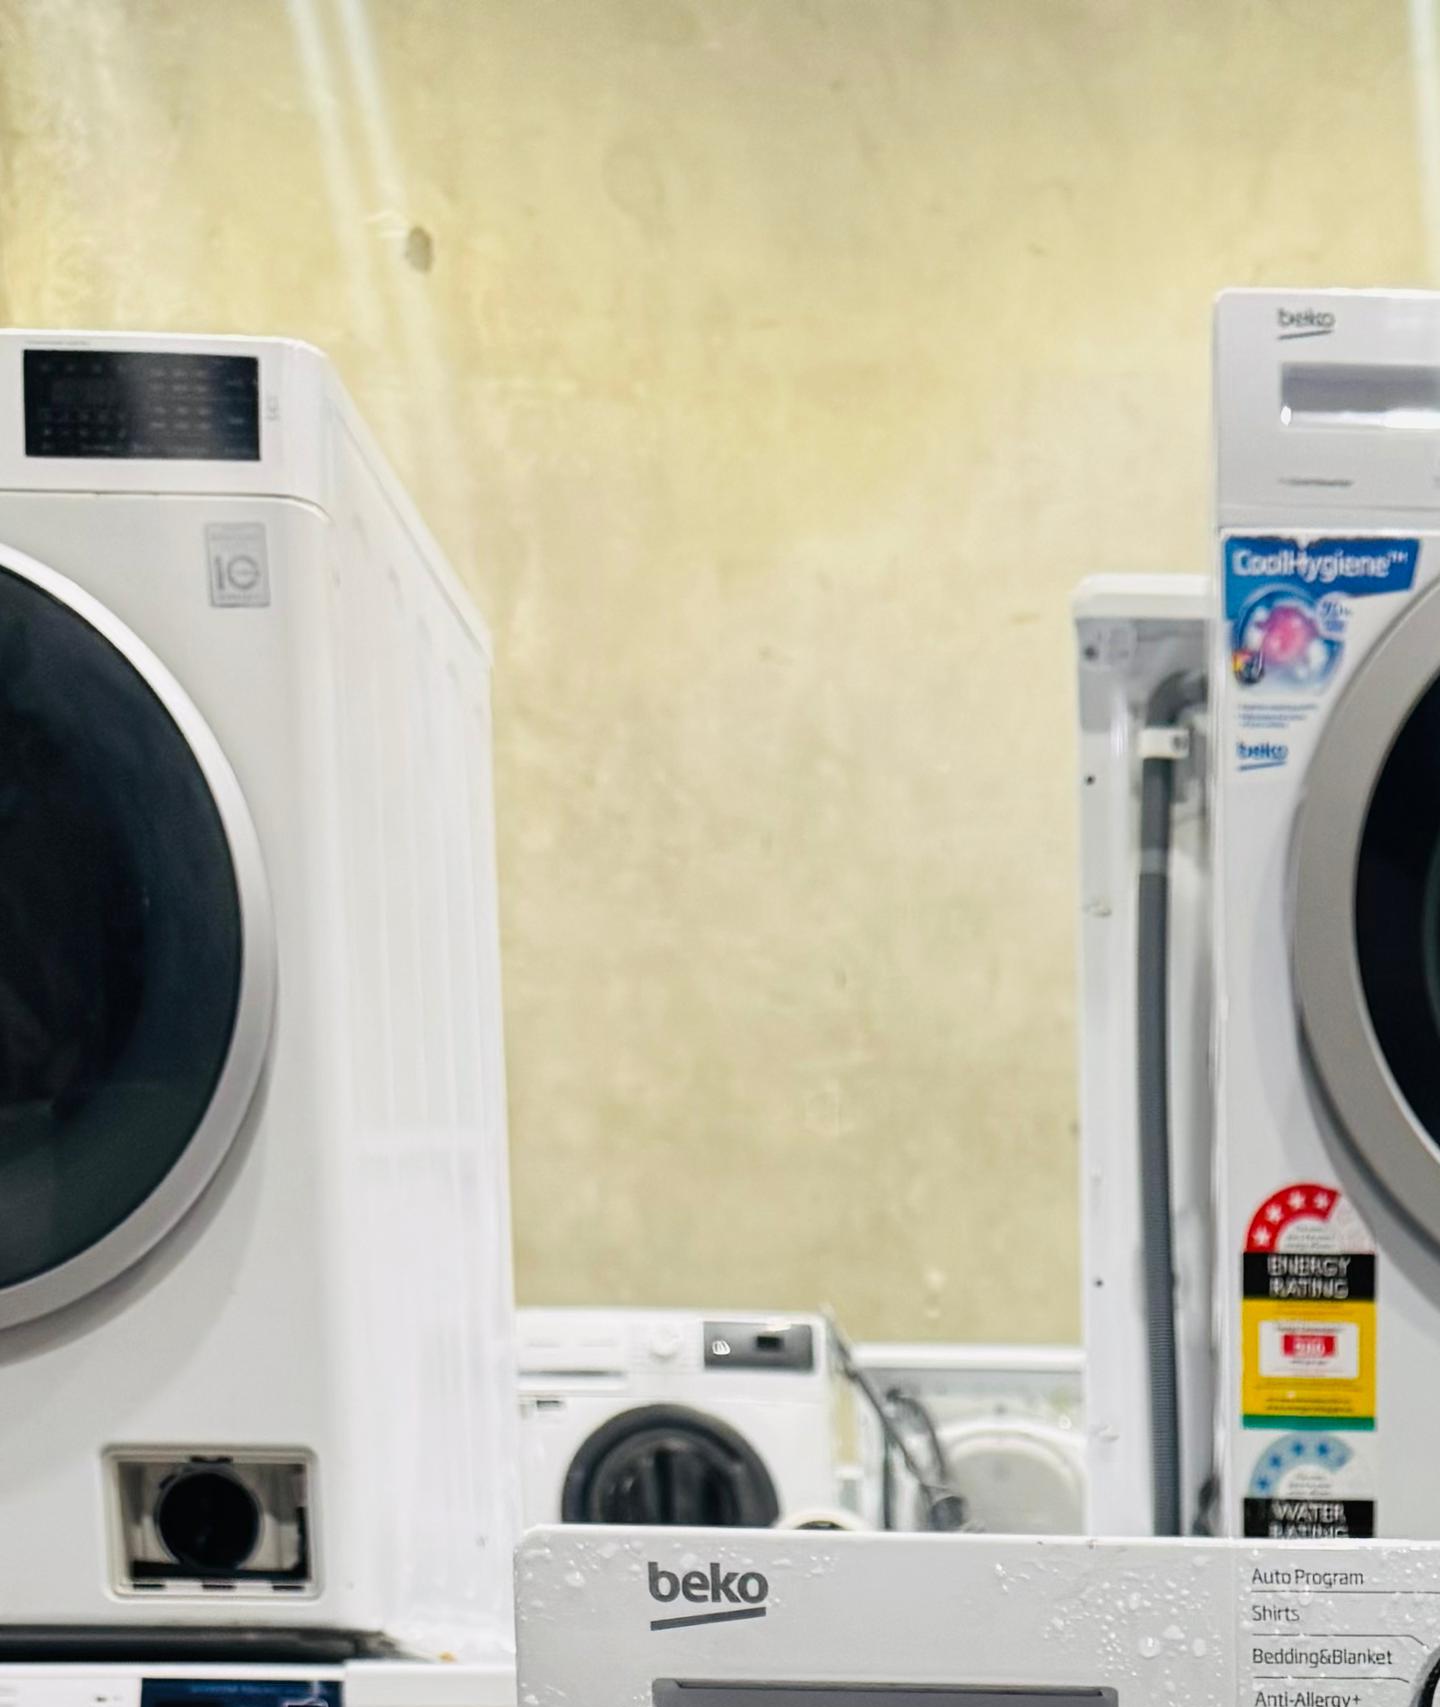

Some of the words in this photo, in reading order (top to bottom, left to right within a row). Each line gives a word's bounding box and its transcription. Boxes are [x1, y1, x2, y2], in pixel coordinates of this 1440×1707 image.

[1267, 1256, 1351, 1277] ENERGY
[1269, 1277, 1349, 1299] RATING
[1271, 1503, 1346, 1522] WATER
[647, 1561, 768, 1604] beko
[1252, 1568, 1291, 1585] Auto
[1295, 1569, 1364, 1588] Program
[1252, 1605, 1300, 1622] Shirts
[1252, 1648, 1392, 1668] Bedding&Blanket
